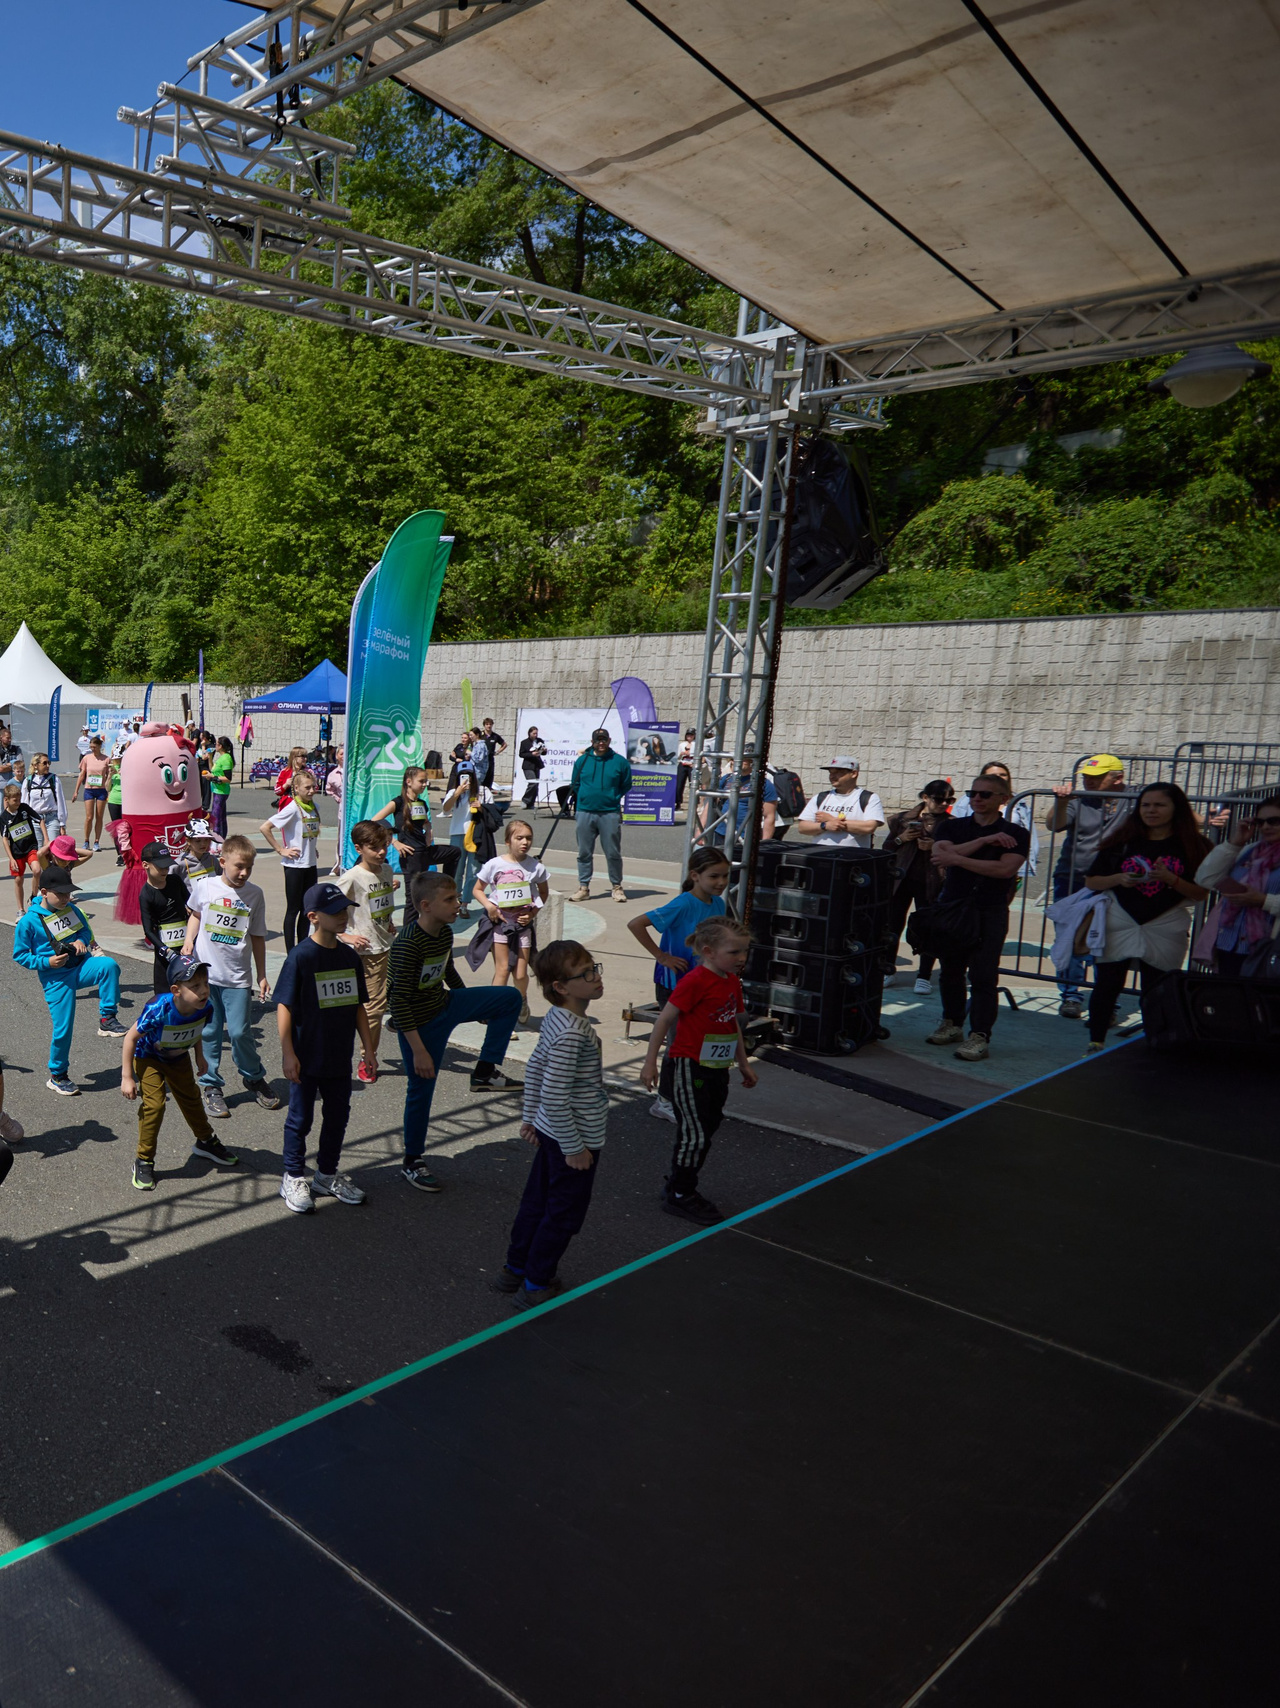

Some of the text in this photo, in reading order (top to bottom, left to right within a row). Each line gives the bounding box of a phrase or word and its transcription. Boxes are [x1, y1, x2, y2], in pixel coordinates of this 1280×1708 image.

[373, 627, 410, 648] зелёный
[370, 640, 410, 661] марафон
[632, 774, 673, 782] РЕНИРУЙТЕСЬ
[504, 889, 523, 899] 773
[54, 916, 71, 931] 723
[216, 913, 238, 928] 782
[166, 929, 185, 940] 722
[322, 981, 352, 996] 1185
[173, 1029, 195, 1041] 771
[710, 1045, 731, 1058] 728
